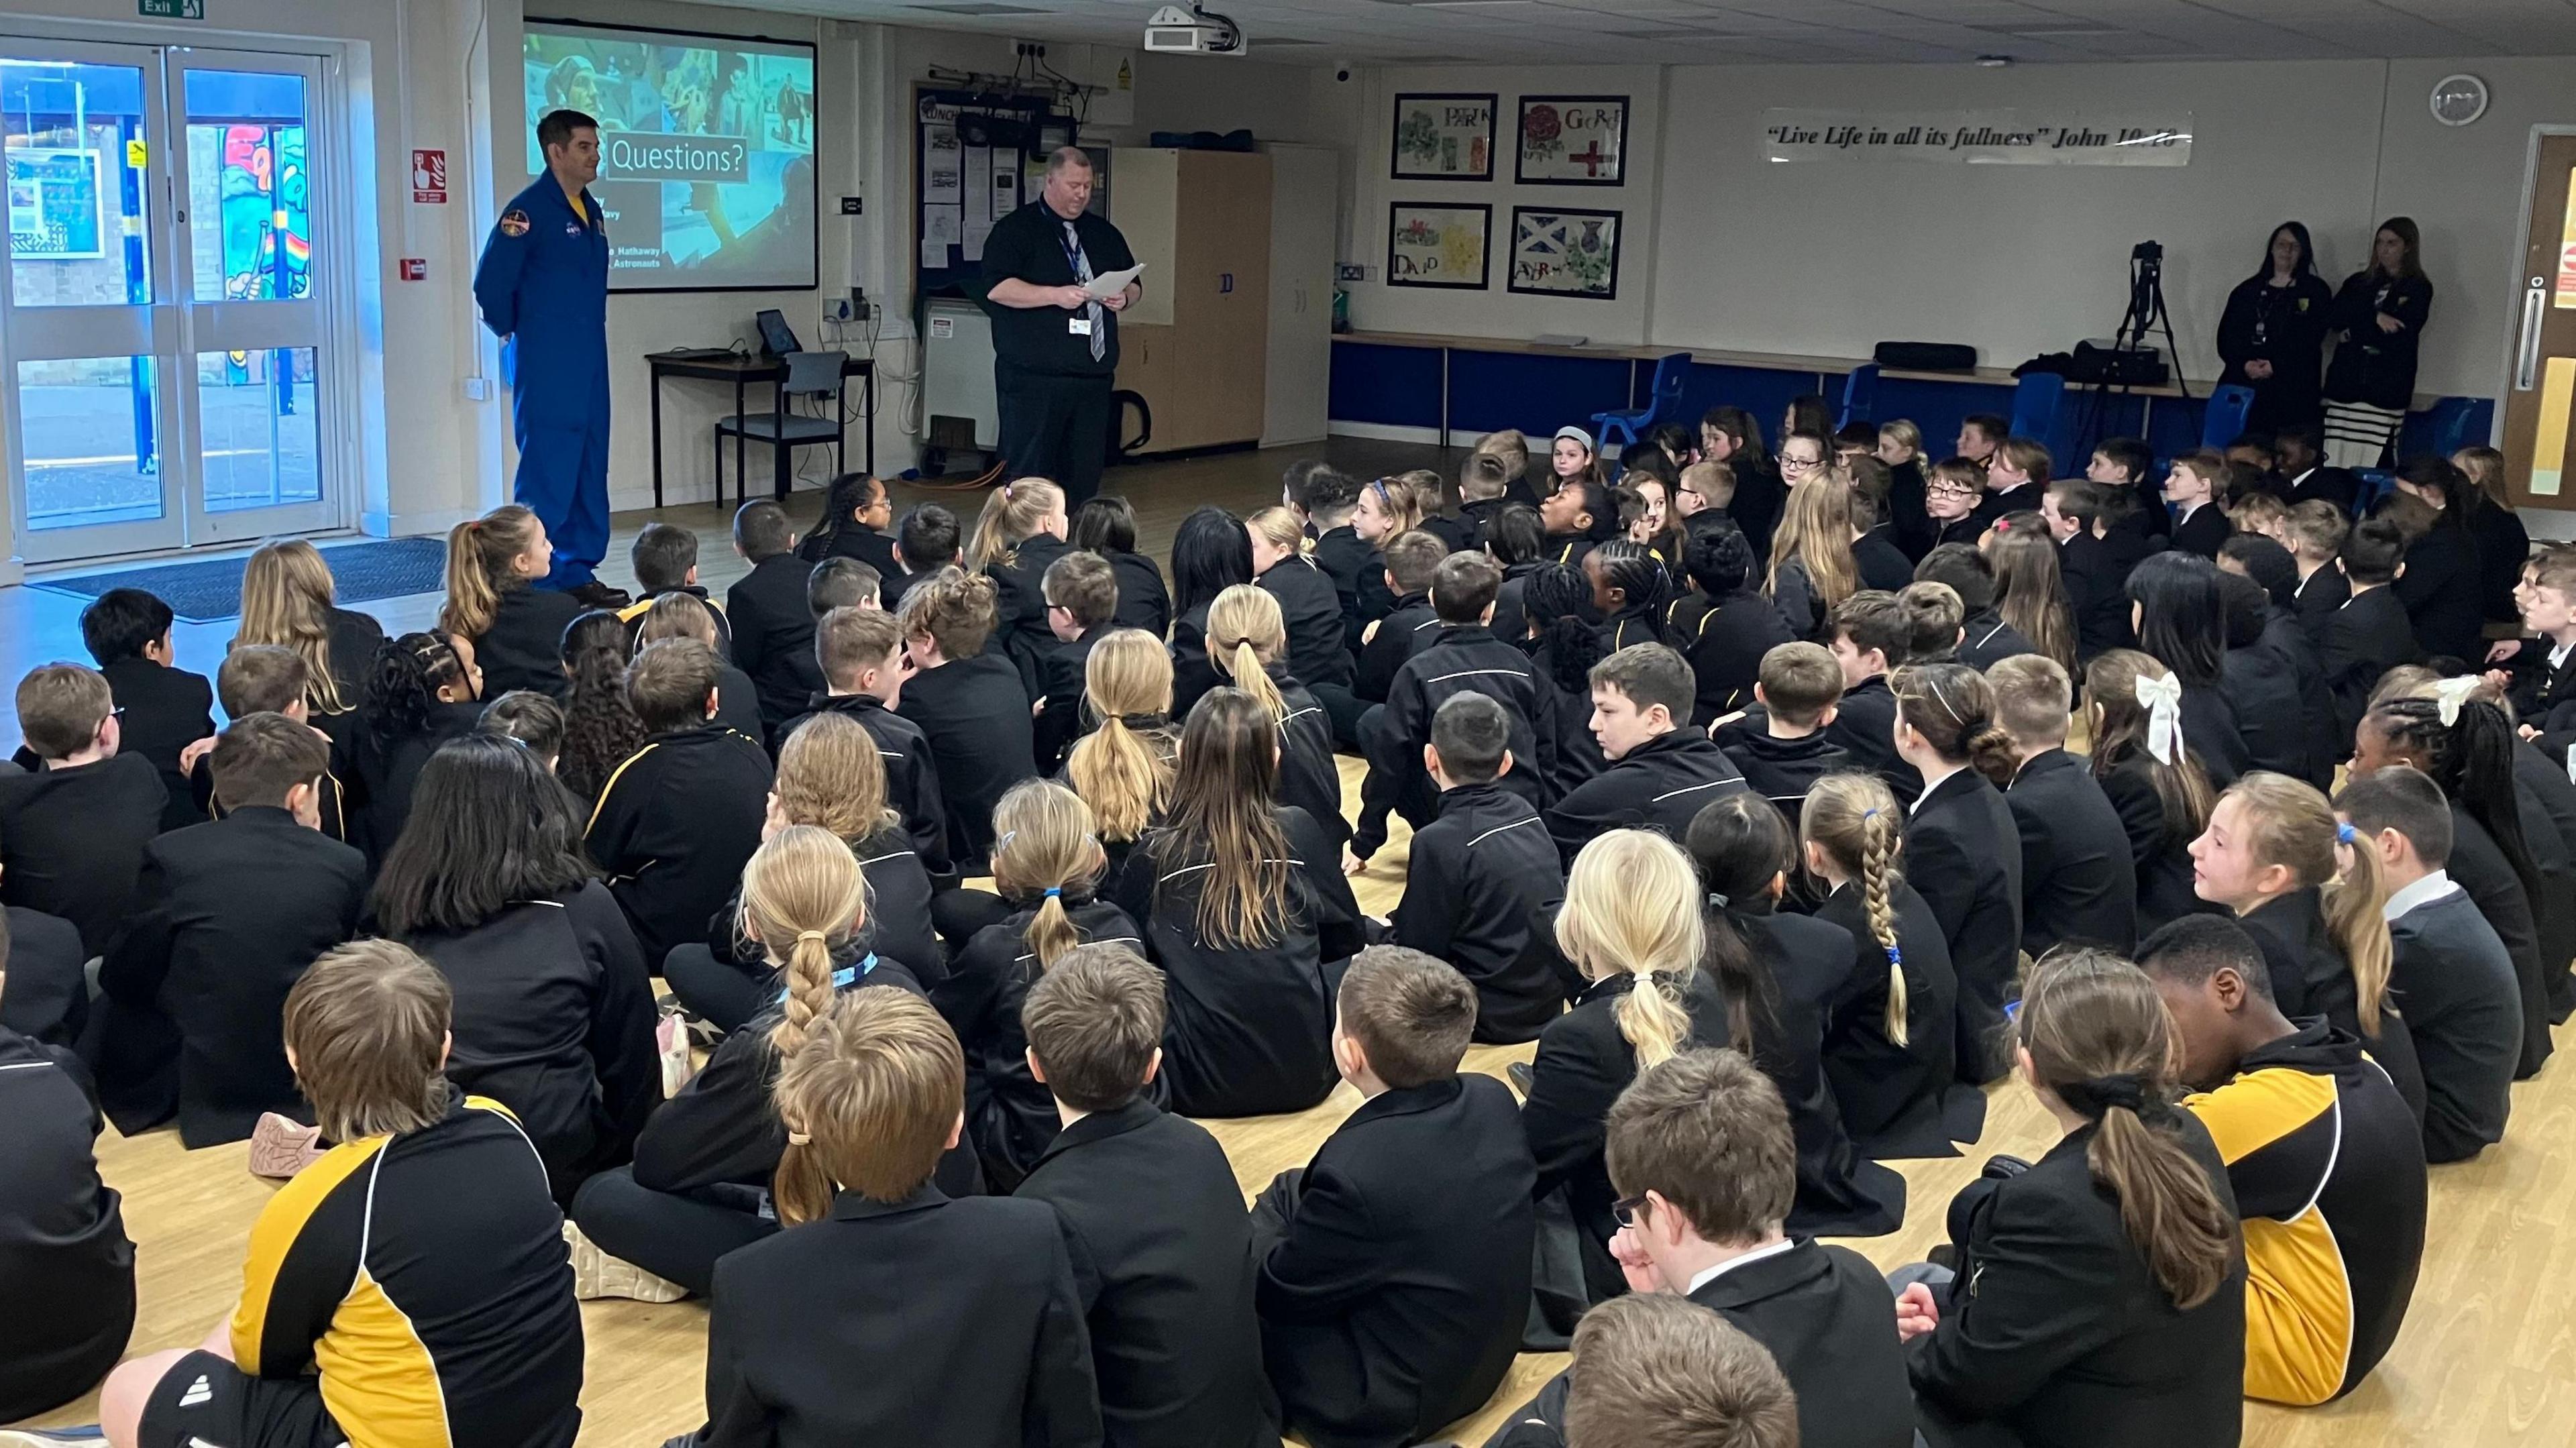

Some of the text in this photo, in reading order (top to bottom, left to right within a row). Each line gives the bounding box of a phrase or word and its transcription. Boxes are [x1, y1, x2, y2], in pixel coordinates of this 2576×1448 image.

[145, 0, 170, 13] Exit
[1768, 126, 1819, 144] “Live
[1824, 125, 1863, 149] Life
[1868, 127, 1888, 145] in
[1893, 126, 1921, 145] all
[1925, 127, 1948, 146] its
[1949, 127, 2050, 150] fullness”
[2052, 127, 2108, 149] John
[612, 140, 743, 172] Questions?
[618, 247, 661, 258] Hathaway
[613, 259, 660, 268] Astronauts
